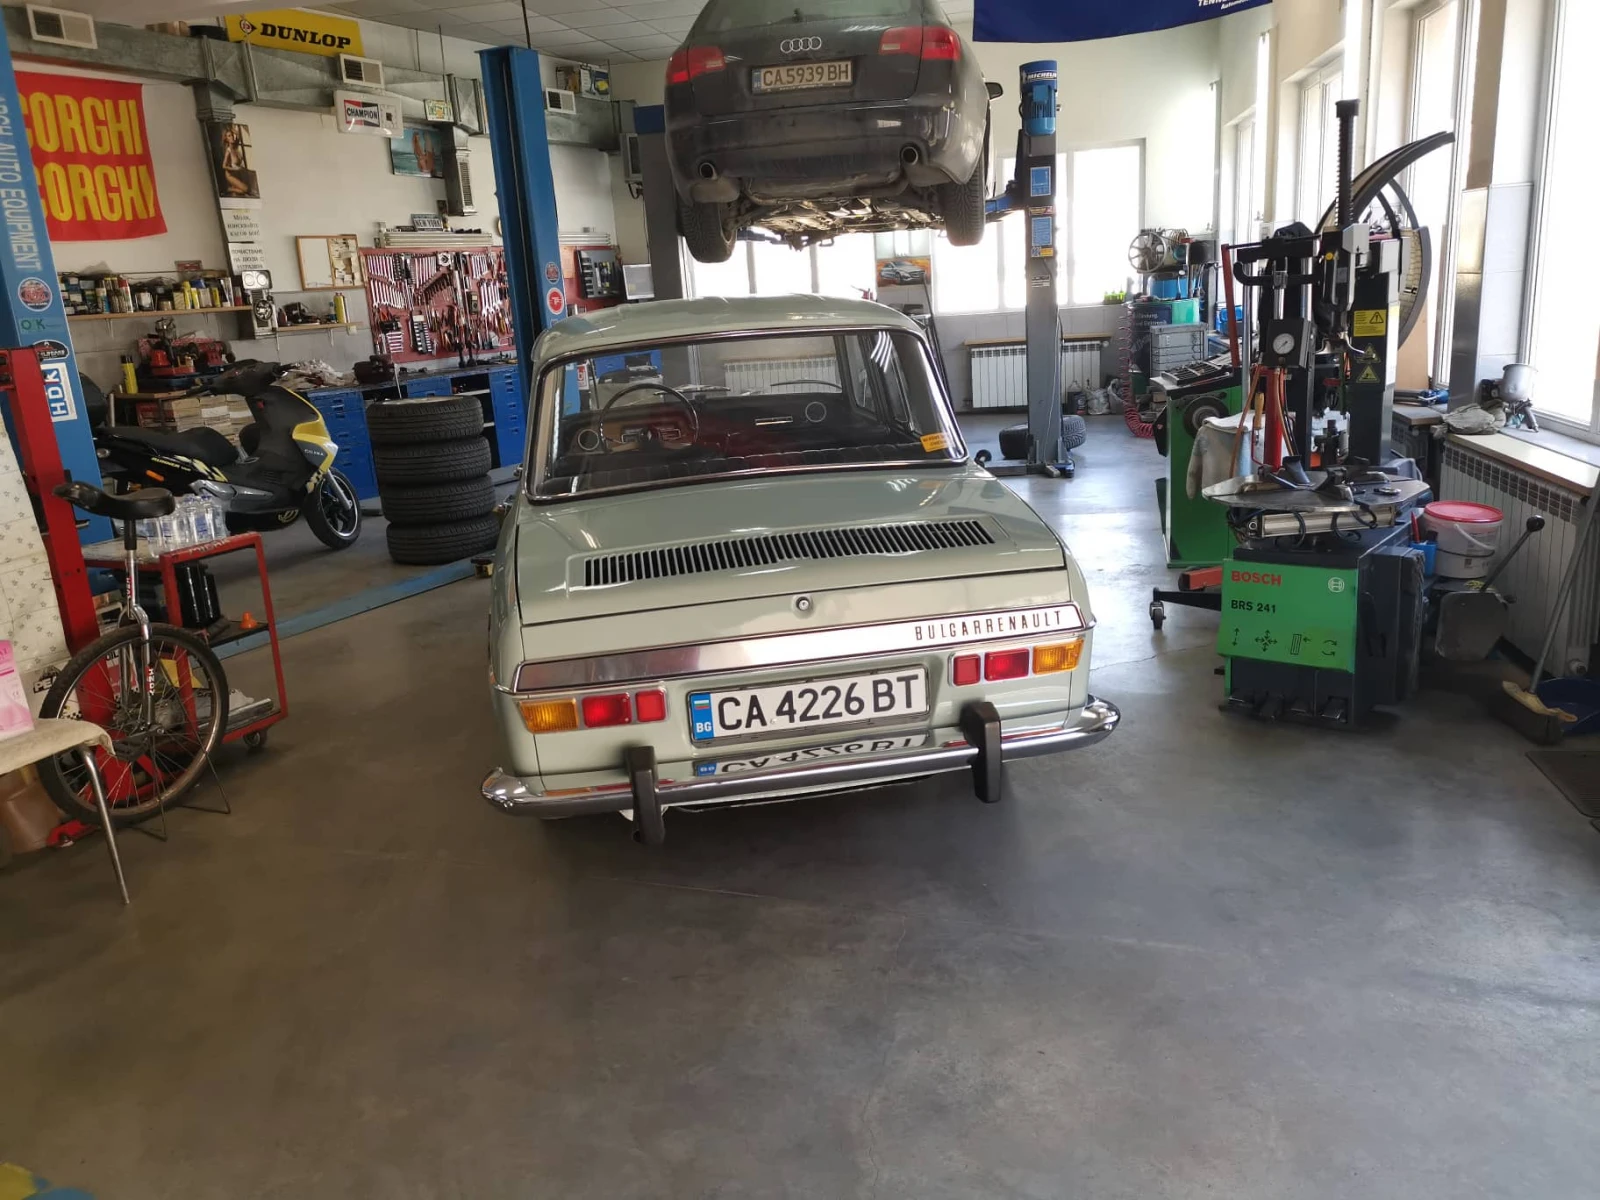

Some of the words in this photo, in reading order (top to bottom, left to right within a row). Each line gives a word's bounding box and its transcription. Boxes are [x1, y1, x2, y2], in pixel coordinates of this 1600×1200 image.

[260, 22, 351, 49] DUNLOP
[763, 69, 785, 87] CA
[786, 65, 825, 85] 5939
[827, 63, 849, 81] BH
[346, 107, 379, 120] CHAMPION
[0, 142, 22, 183] AUTO
[34, 162, 157, 222] ORGHI
[0, 188, 43, 272] EQUIPMENT
[45, 370, 67, 416] HDK
[1231, 570, 1282, 587] BOSCH
[1231, 599, 1253, 611] BRS
[1257, 603, 1277, 614] 241
[915, 610, 1062, 641] BULGARRENAULT
[695, 722, 712, 733] BG
[717, 694, 768, 731] CA
[775, 681, 866, 725] 4226
[872, 674, 920, 713] BT
